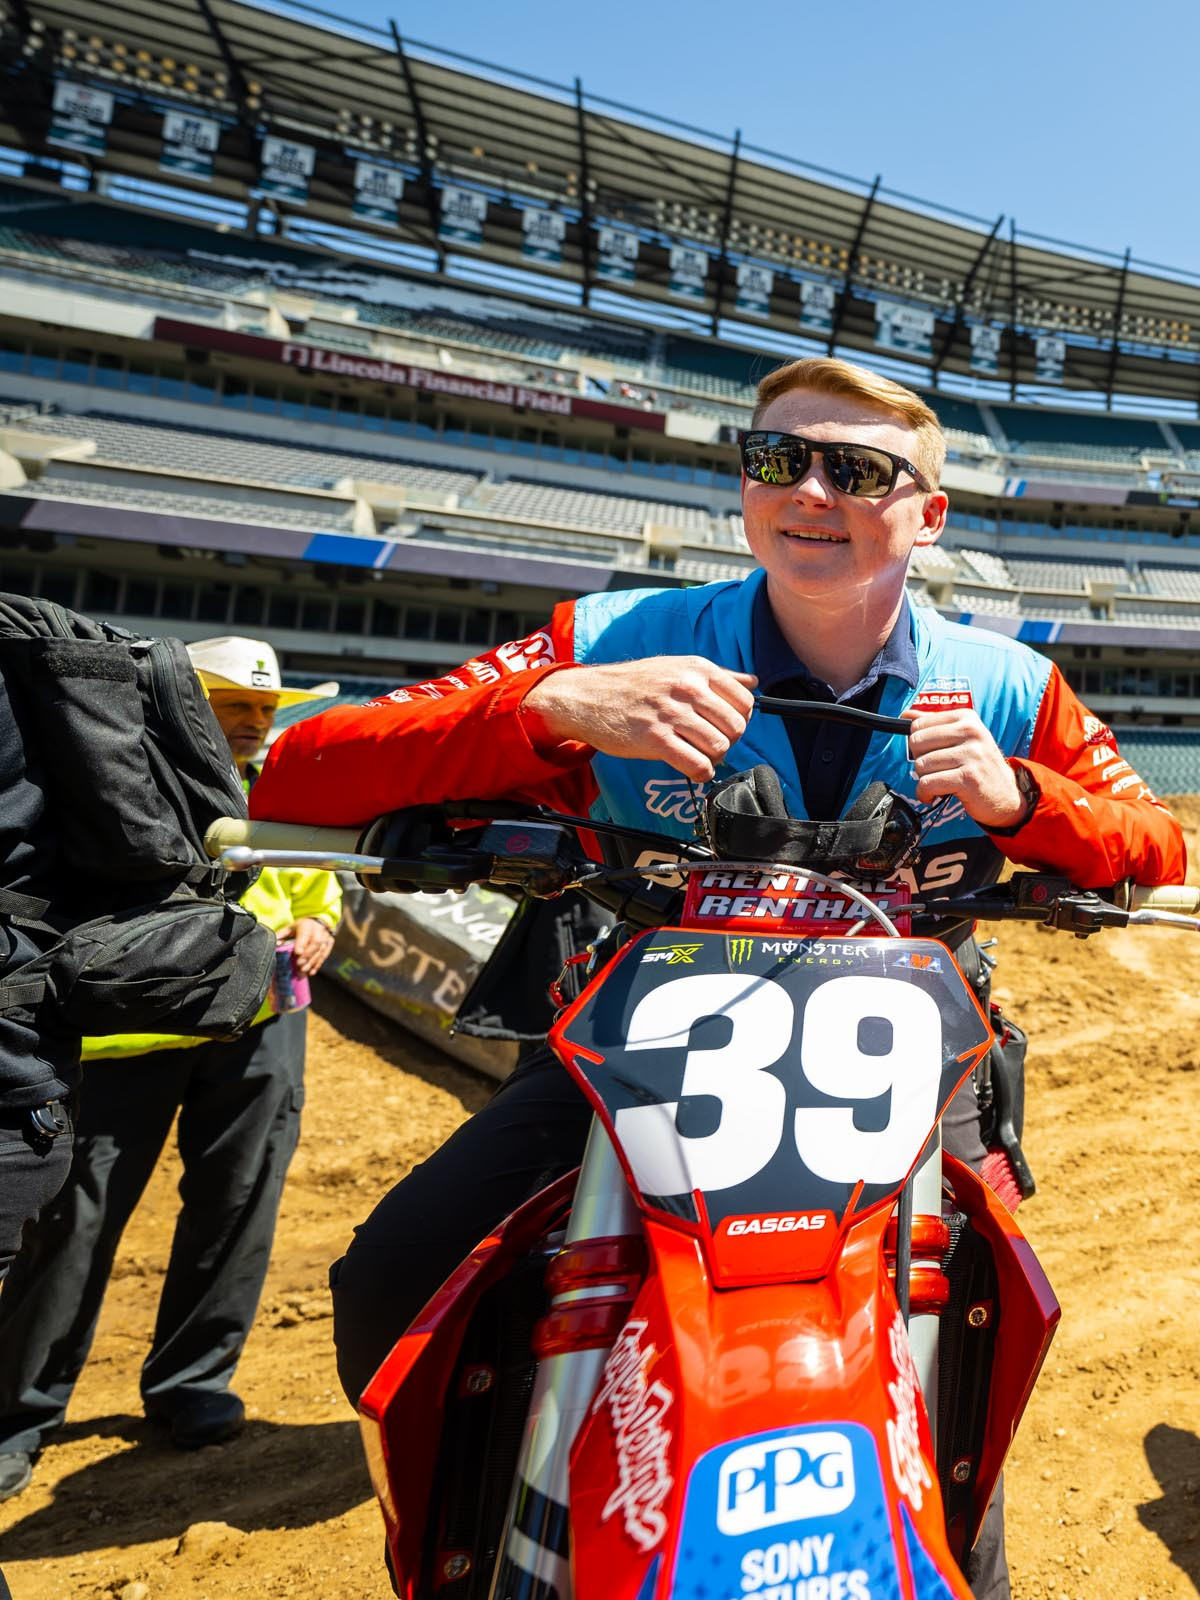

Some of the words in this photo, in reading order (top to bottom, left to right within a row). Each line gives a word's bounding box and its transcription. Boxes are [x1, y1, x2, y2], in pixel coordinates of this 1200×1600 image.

[313, 350, 407, 386] Lincoln
[408, 369, 513, 403] Financial
[515, 389, 572, 416] Field
[641, 944, 704, 965] SMX
[761, 941, 870, 959] MONSTER
[777, 958, 854, 966] ENERGY
[894, 952, 944, 974] AMA
[614, 973, 942, 1197] 39
[727, 1215, 827, 1236] GASGAS
[727, 1446, 844, 1515] PPG
[740, 1532, 835, 1593] SONY
